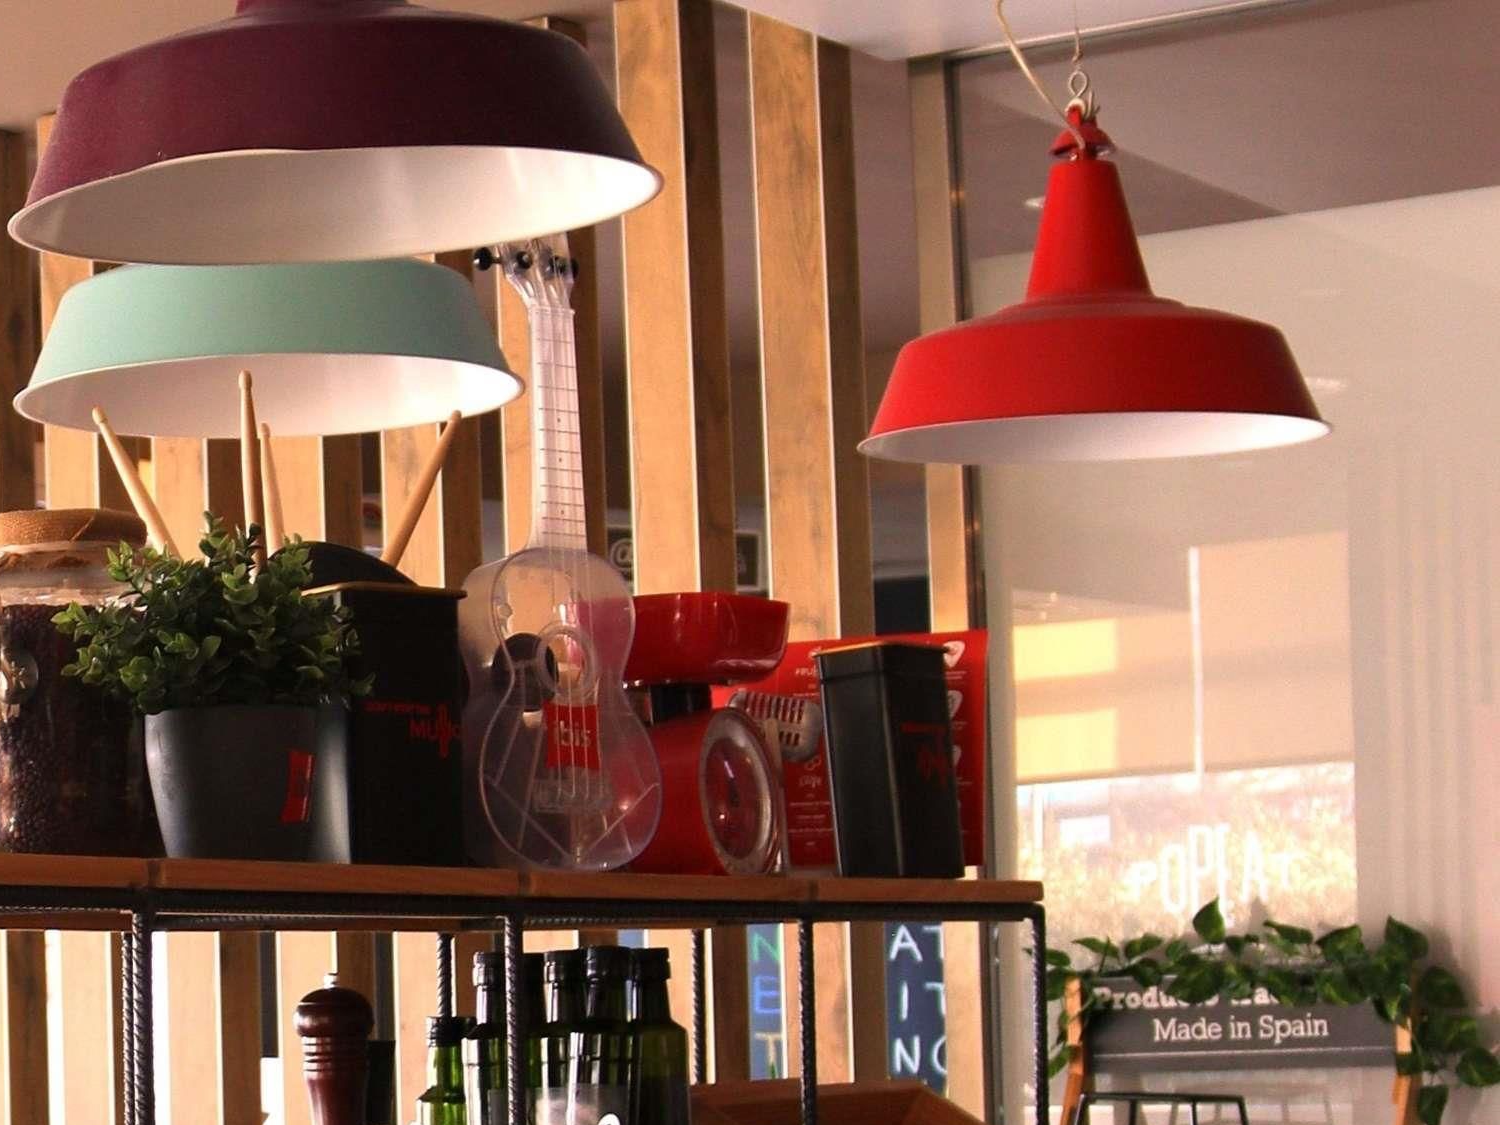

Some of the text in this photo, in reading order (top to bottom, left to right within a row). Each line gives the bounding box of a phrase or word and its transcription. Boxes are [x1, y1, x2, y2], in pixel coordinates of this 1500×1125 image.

[1152, 1012, 1330, 1046] Made in Spain
